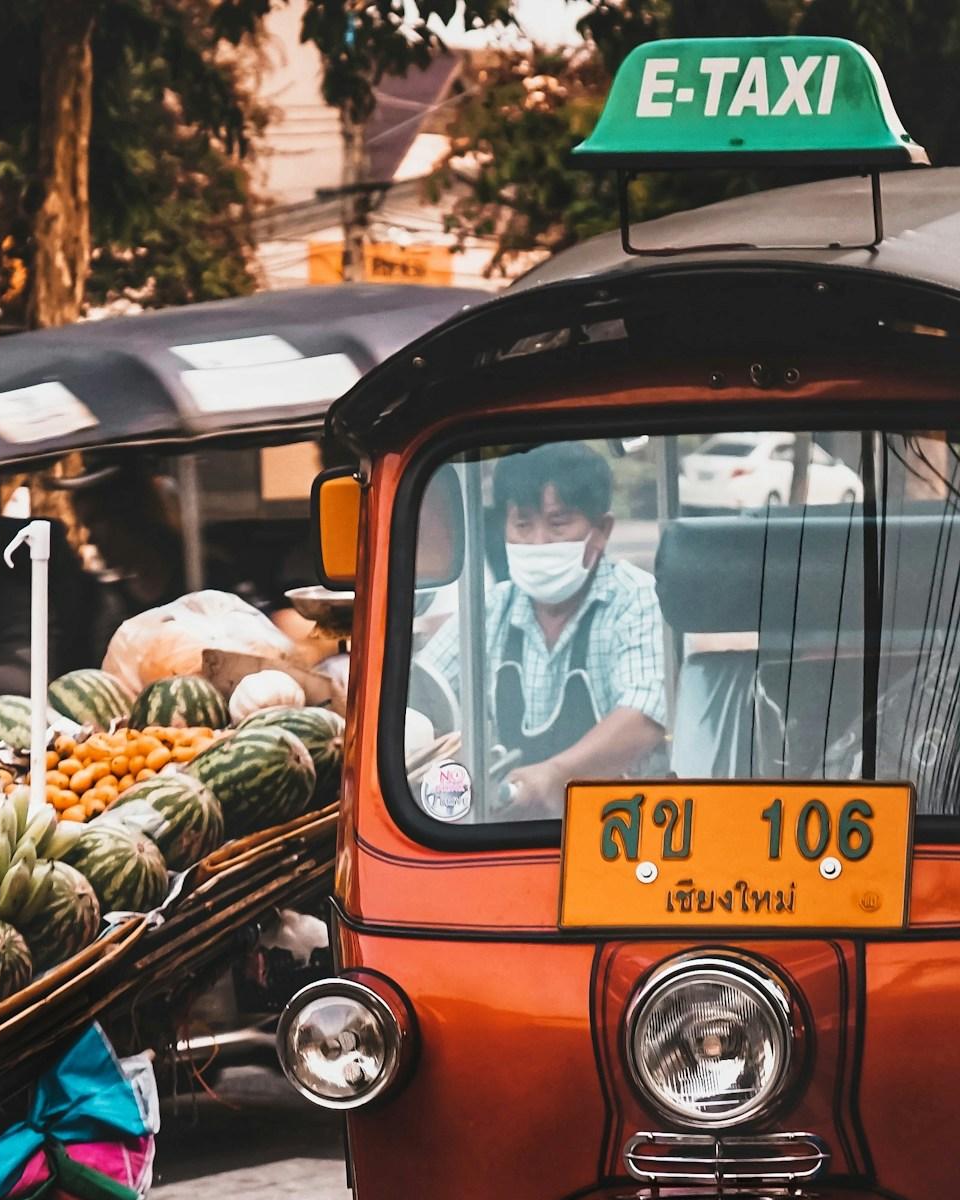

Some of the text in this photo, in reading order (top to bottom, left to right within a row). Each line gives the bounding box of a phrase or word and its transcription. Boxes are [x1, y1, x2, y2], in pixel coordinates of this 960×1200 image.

[635, 55, 840, 118] E-TAXI
[600, 794, 875, 862] สข 106
[665, 878, 797, 914] เชียงใหม่
